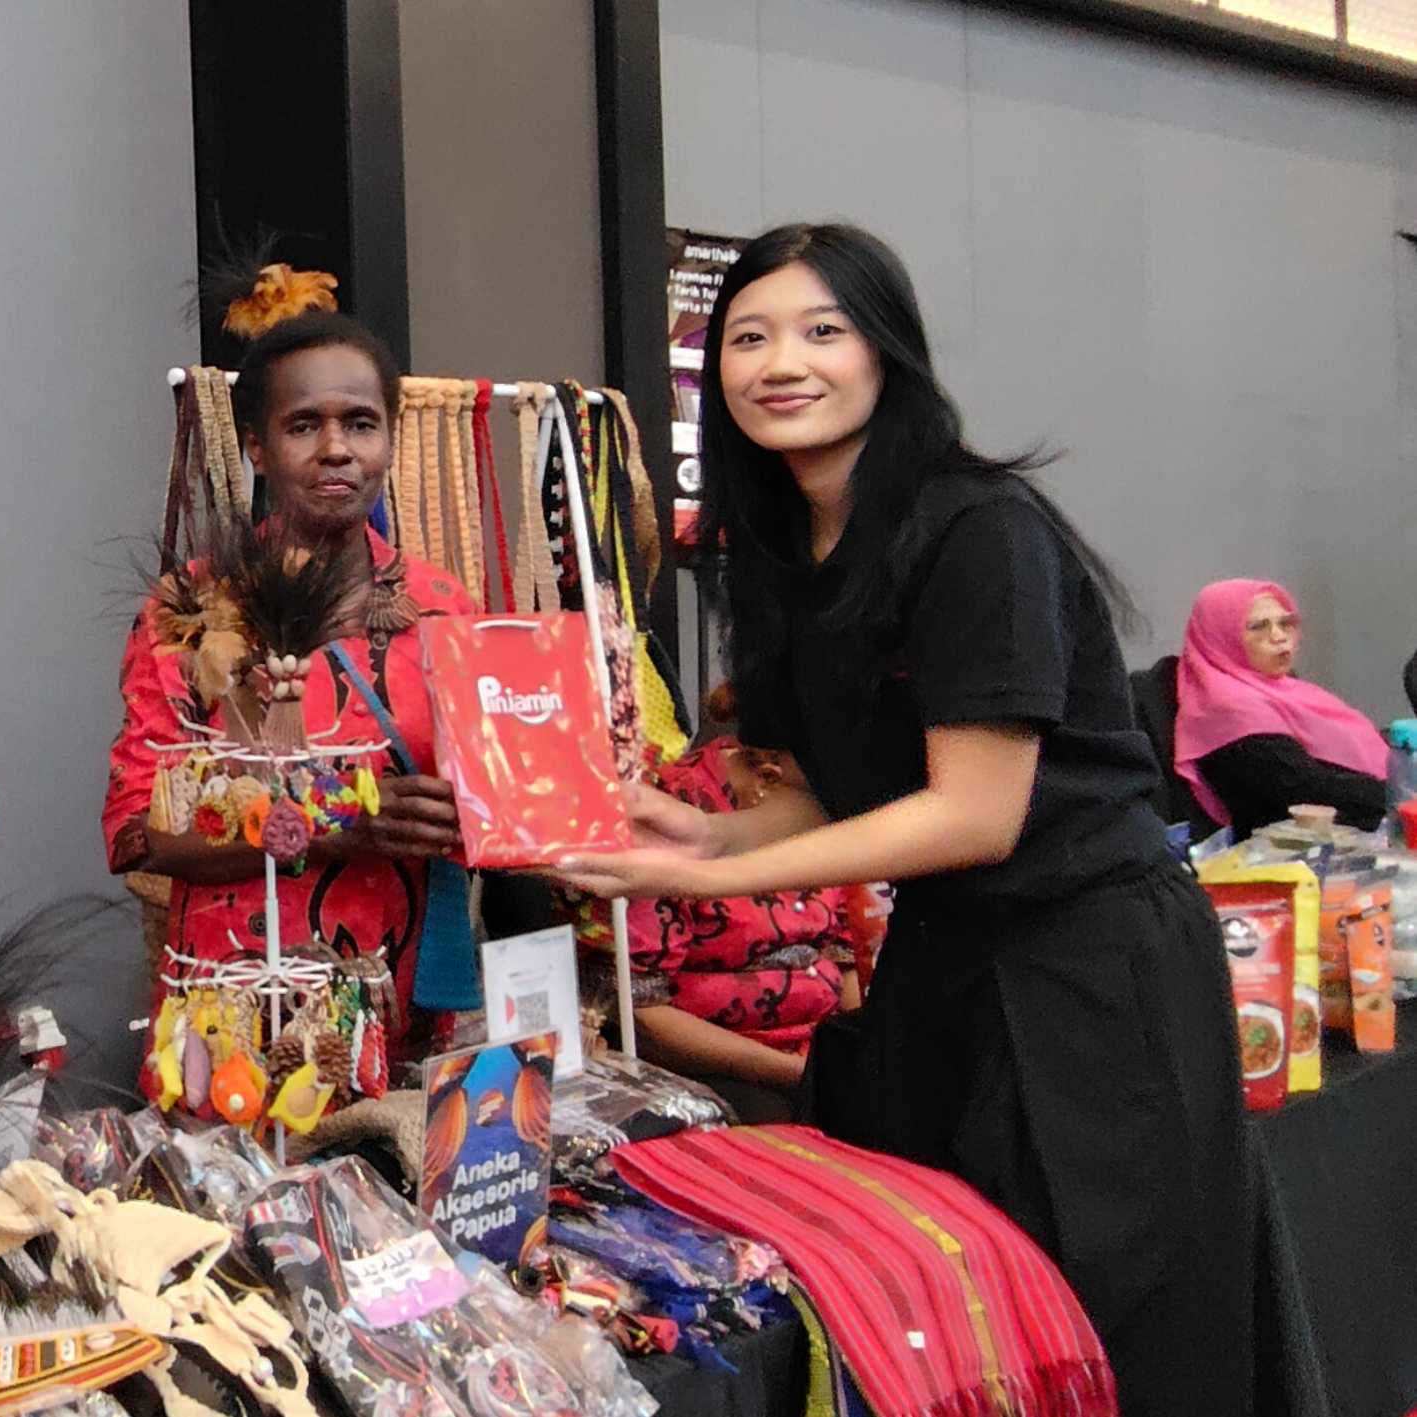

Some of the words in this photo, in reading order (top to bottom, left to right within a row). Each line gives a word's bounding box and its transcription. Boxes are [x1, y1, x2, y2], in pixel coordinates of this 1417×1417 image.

[478, 675, 563, 724] Pinjamin
[452, 1151, 521, 1190] Aneka
[430, 1169, 540, 1224] Aksesoris
[450, 1205, 517, 1244] Papua
